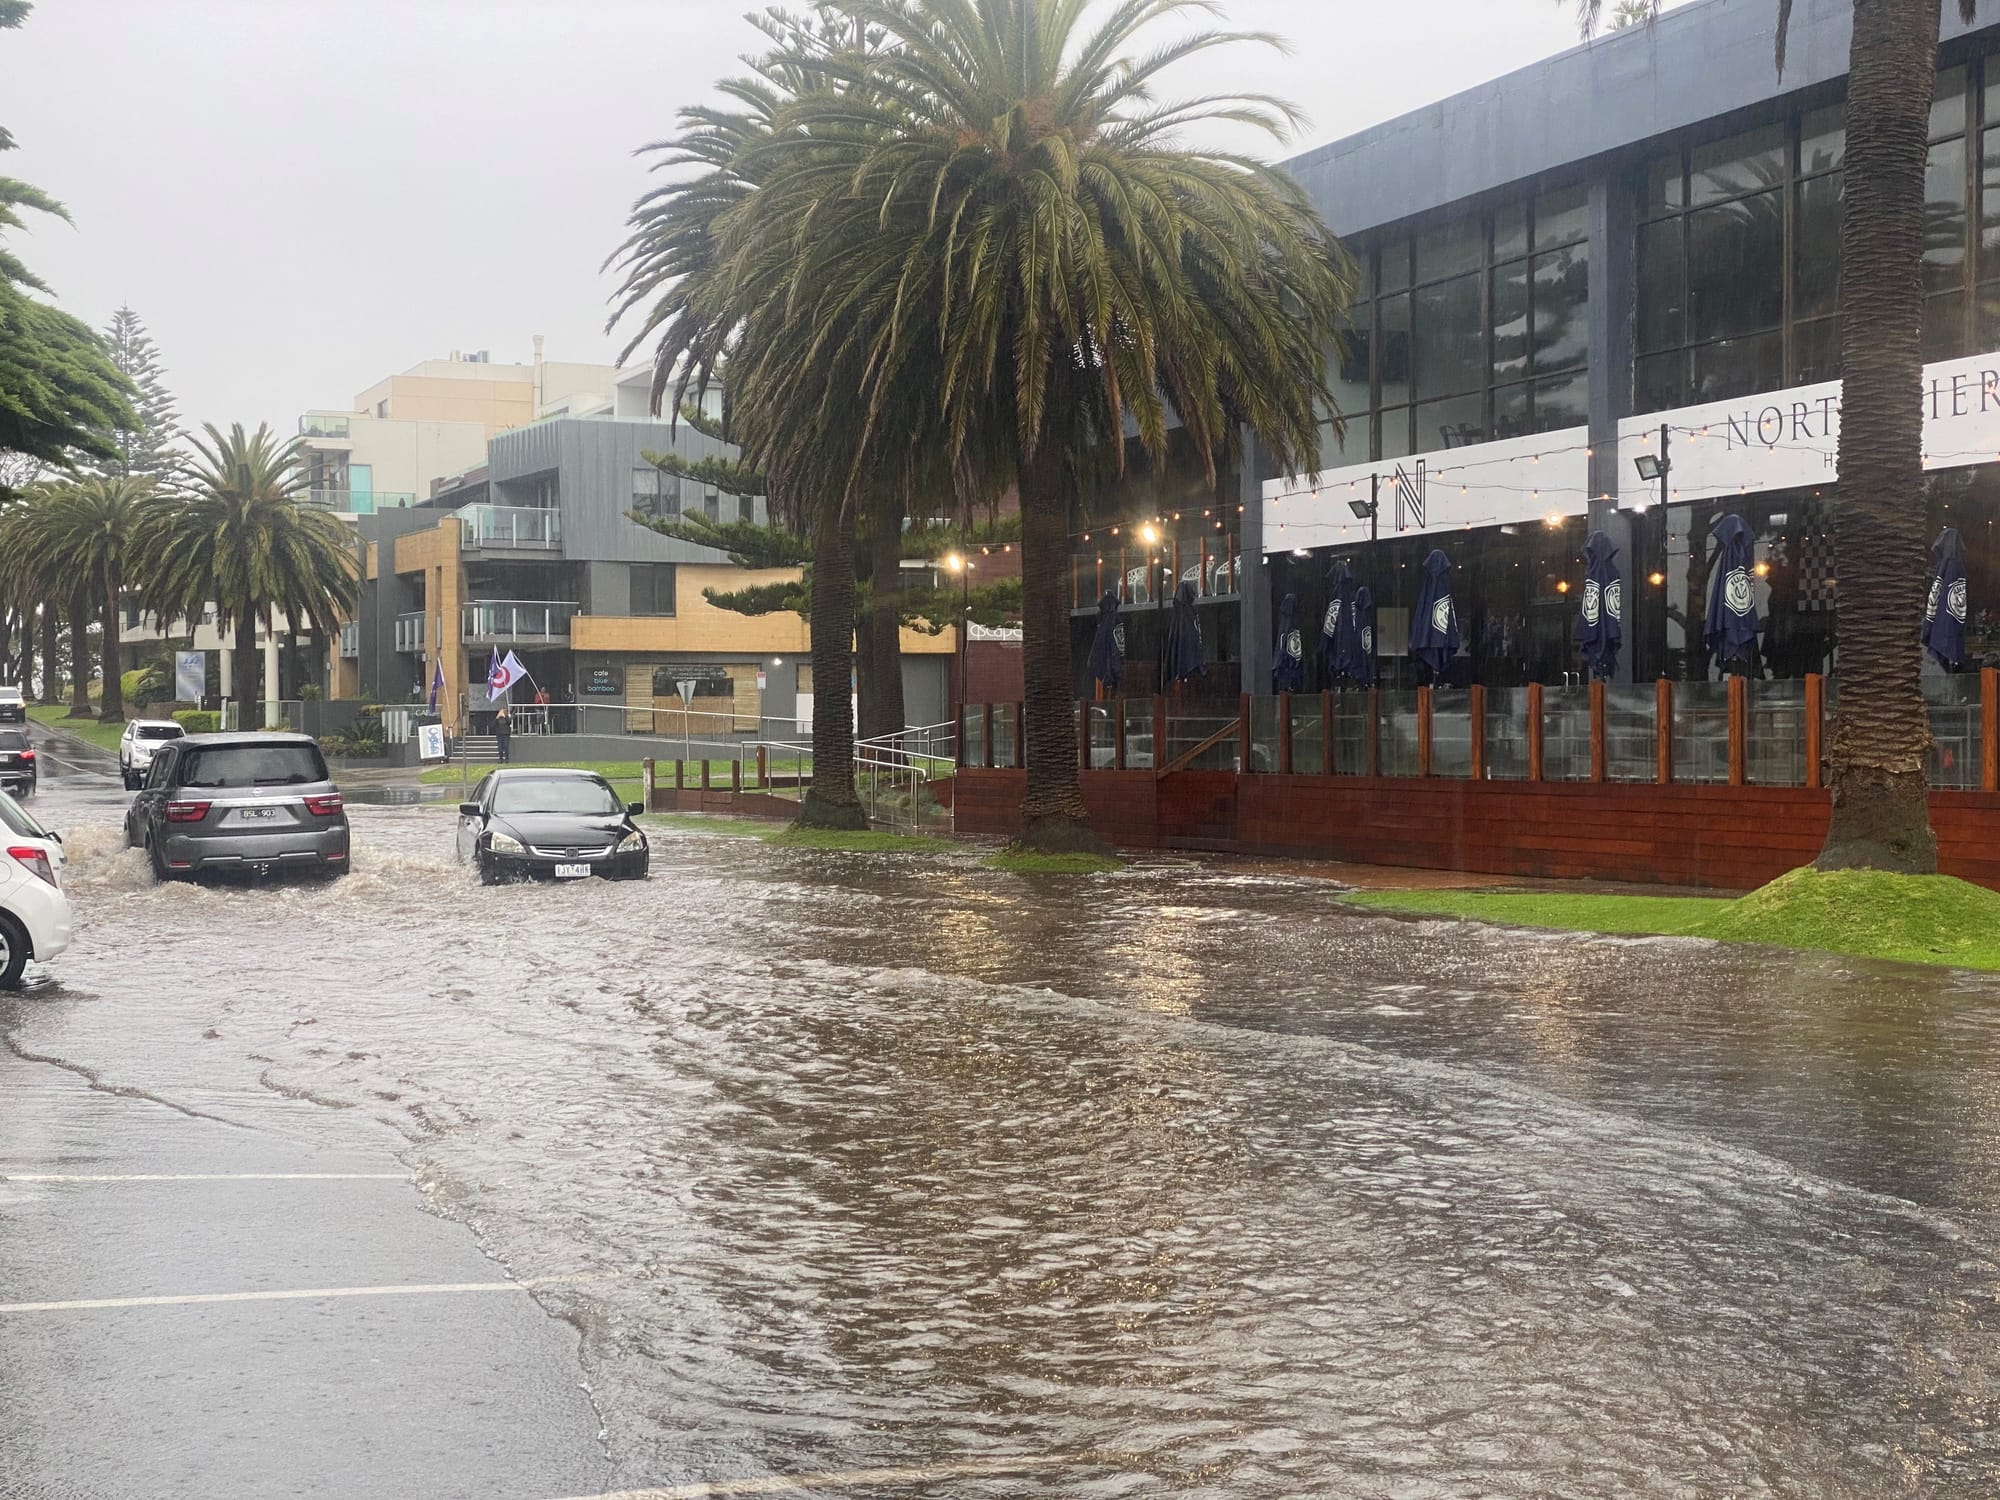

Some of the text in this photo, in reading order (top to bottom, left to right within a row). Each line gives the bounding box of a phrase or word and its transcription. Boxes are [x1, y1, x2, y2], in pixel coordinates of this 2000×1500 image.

[1727, 369, 2000, 450] NORT IER
[1395, 459, 1425, 532] N
